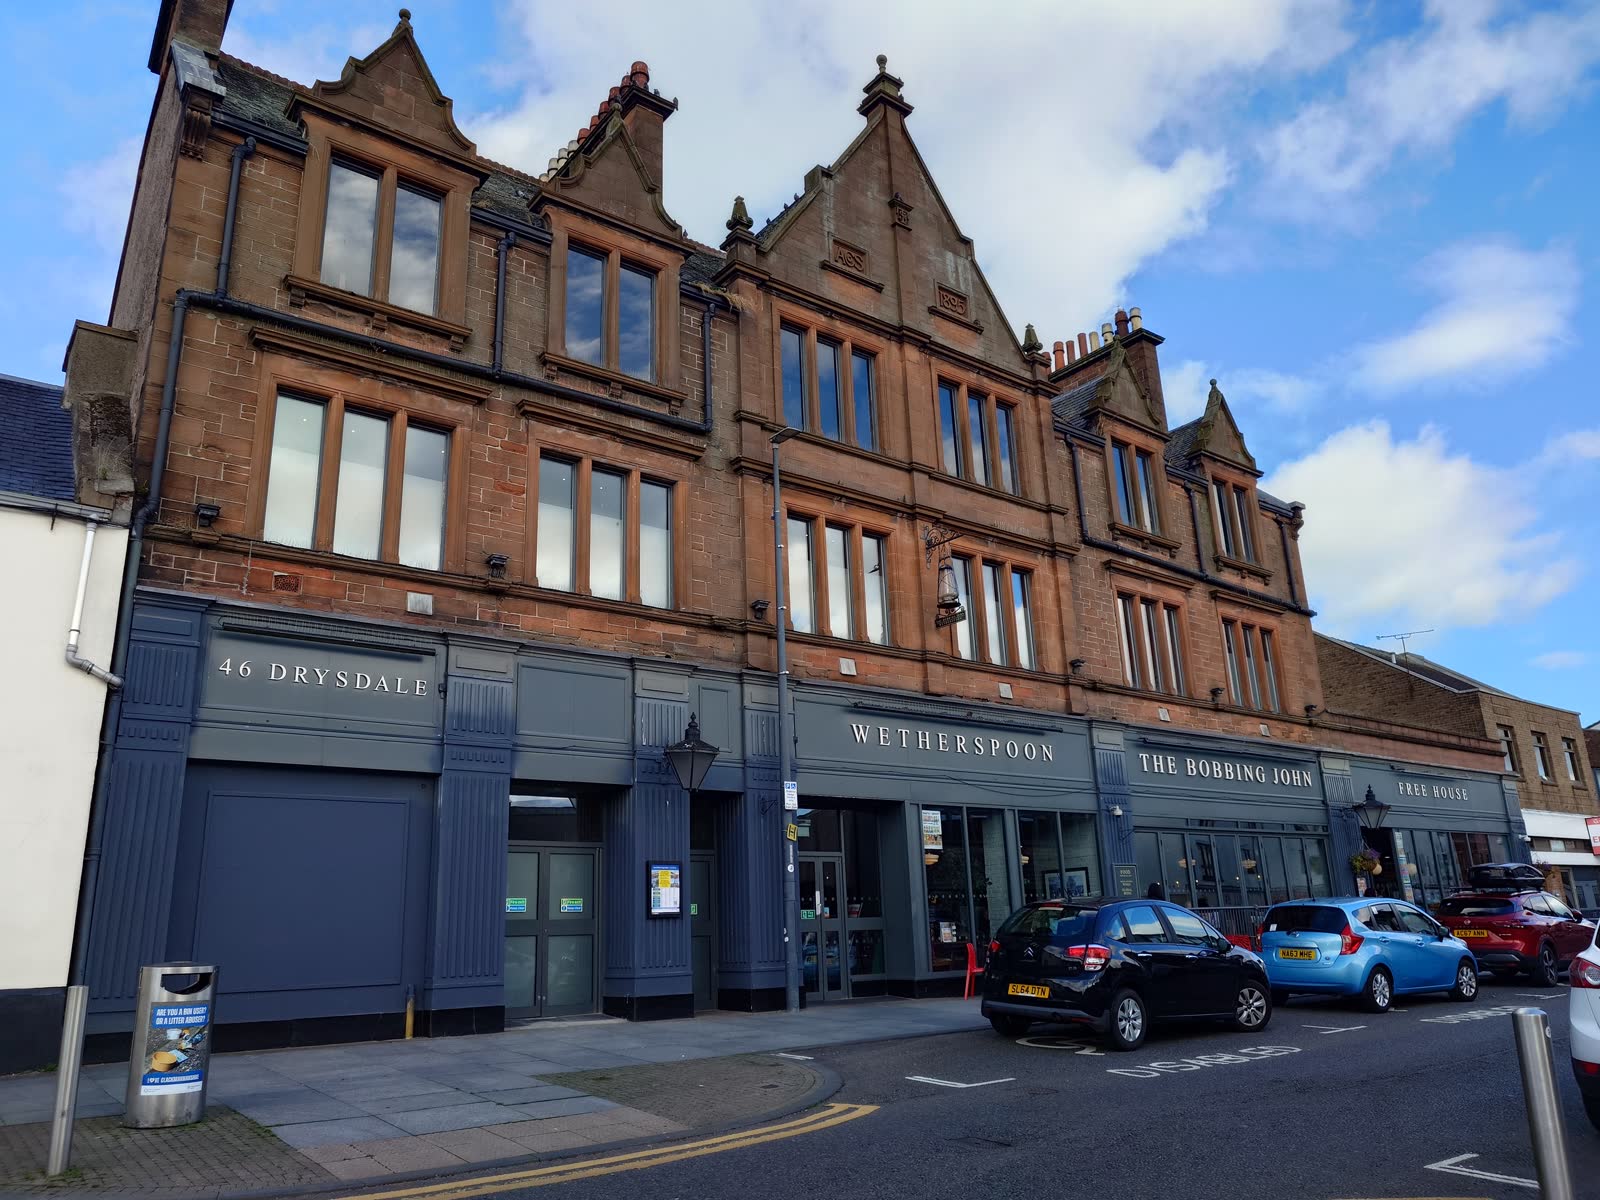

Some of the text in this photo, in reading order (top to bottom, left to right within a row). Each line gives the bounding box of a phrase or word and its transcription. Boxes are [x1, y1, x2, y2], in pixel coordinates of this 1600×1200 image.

[939, 290, 967, 316] 1895
[219, 658, 428, 696] 46 DRYSDALE
[851, 723, 1053, 761] WETHERSPOON
[1139, 753, 1313, 788] THE BOBBING JOHN
[1398, 782, 1468, 801] FREE HOUSE
[1281, 950, 1298, 958] NA63
[1011, 984, 1046, 997] SL64 DTN
[155, 1017, 164, 1025] OR
[168, 1016, 185, 1025] LITTER
[156, 1008, 167, 1016] ARE
[167, 1008, 179, 1016] YOU
[1106, 1045, 1302, 1078] DISABLED
